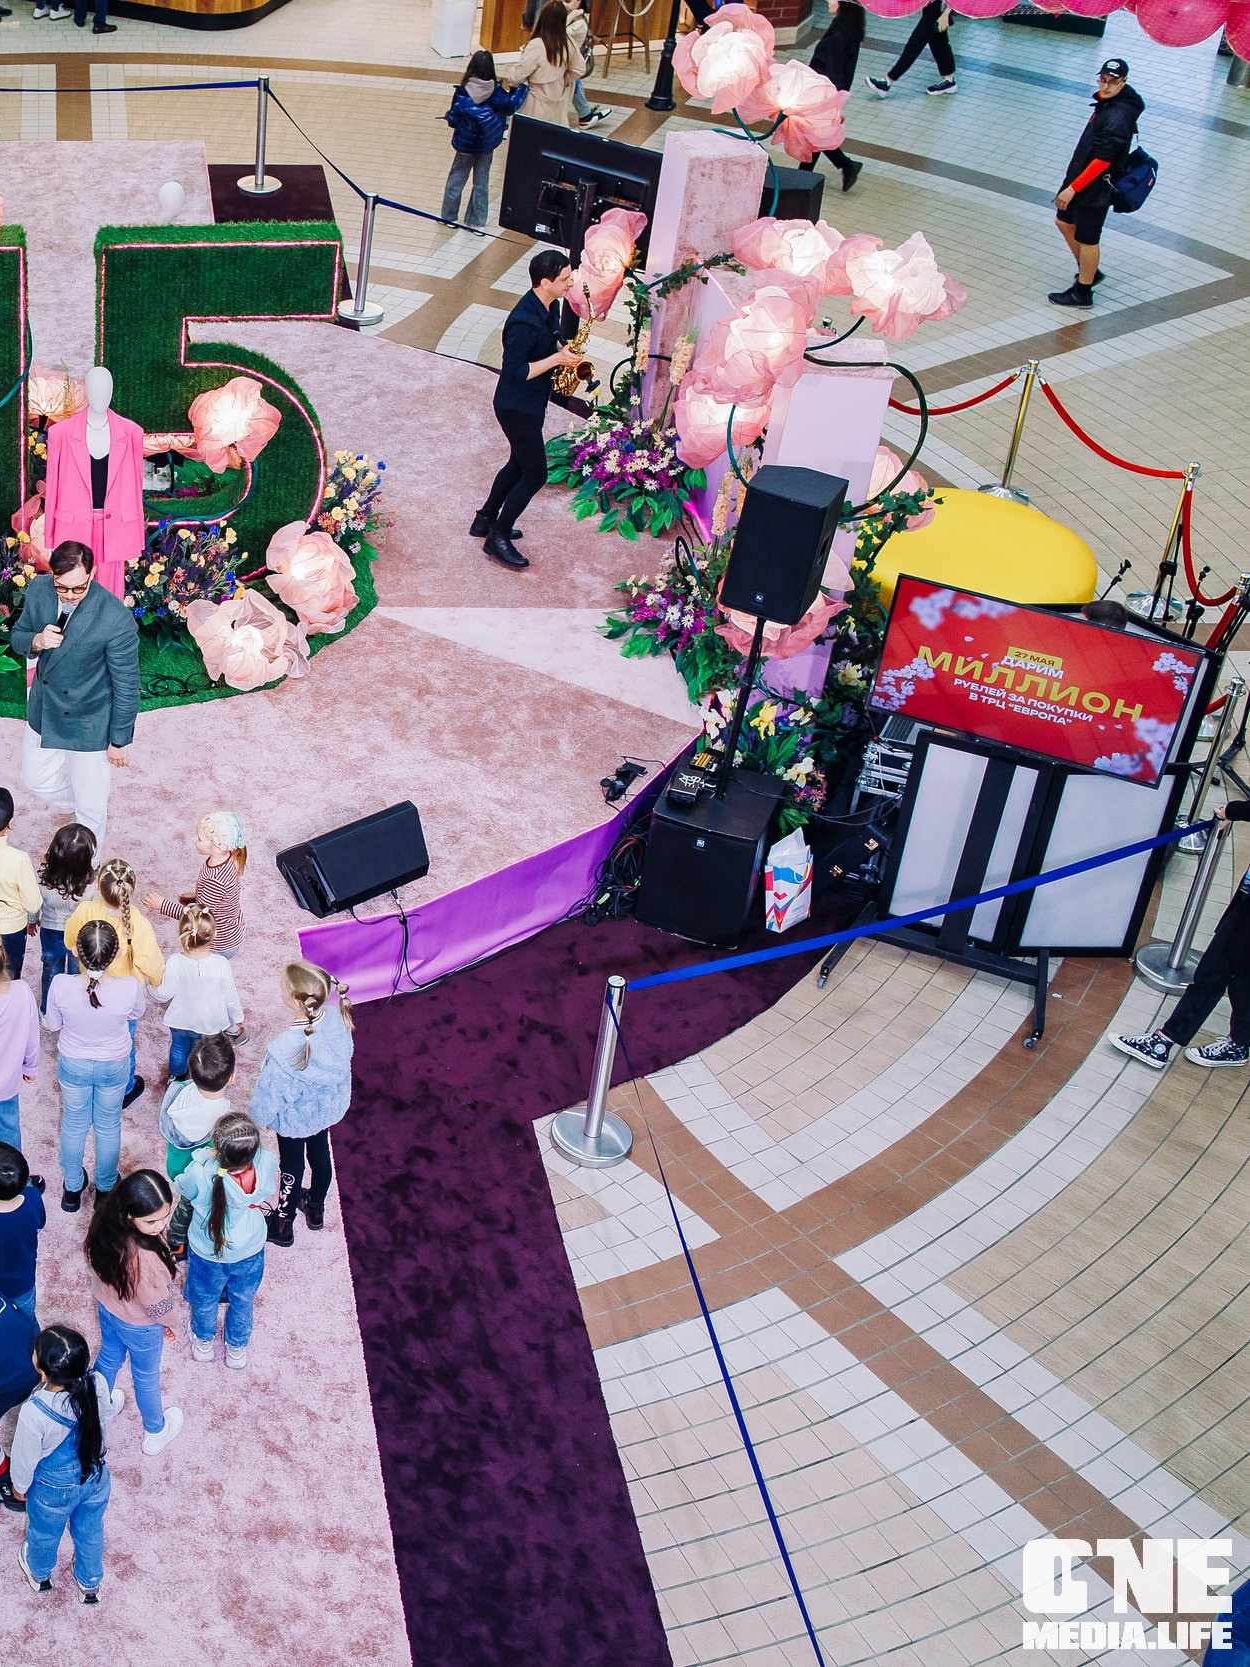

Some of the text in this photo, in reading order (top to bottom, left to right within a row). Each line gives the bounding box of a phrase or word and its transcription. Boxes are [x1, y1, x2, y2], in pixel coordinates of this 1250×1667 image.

[1001, 655, 1064, 679] ДАРИМ
[1014, 651, 1055, 667] 27 МАЯ
[917, 645, 1144, 723] МИЛЛИОН
[953, 678, 1094, 722] РУБЛЕЙ ЗА ПОКУПКИ
[968, 692, 978, 701] В
[980, 695, 1006, 710] ТРЦ
[278, 1185, 293, 1218] SMILE
